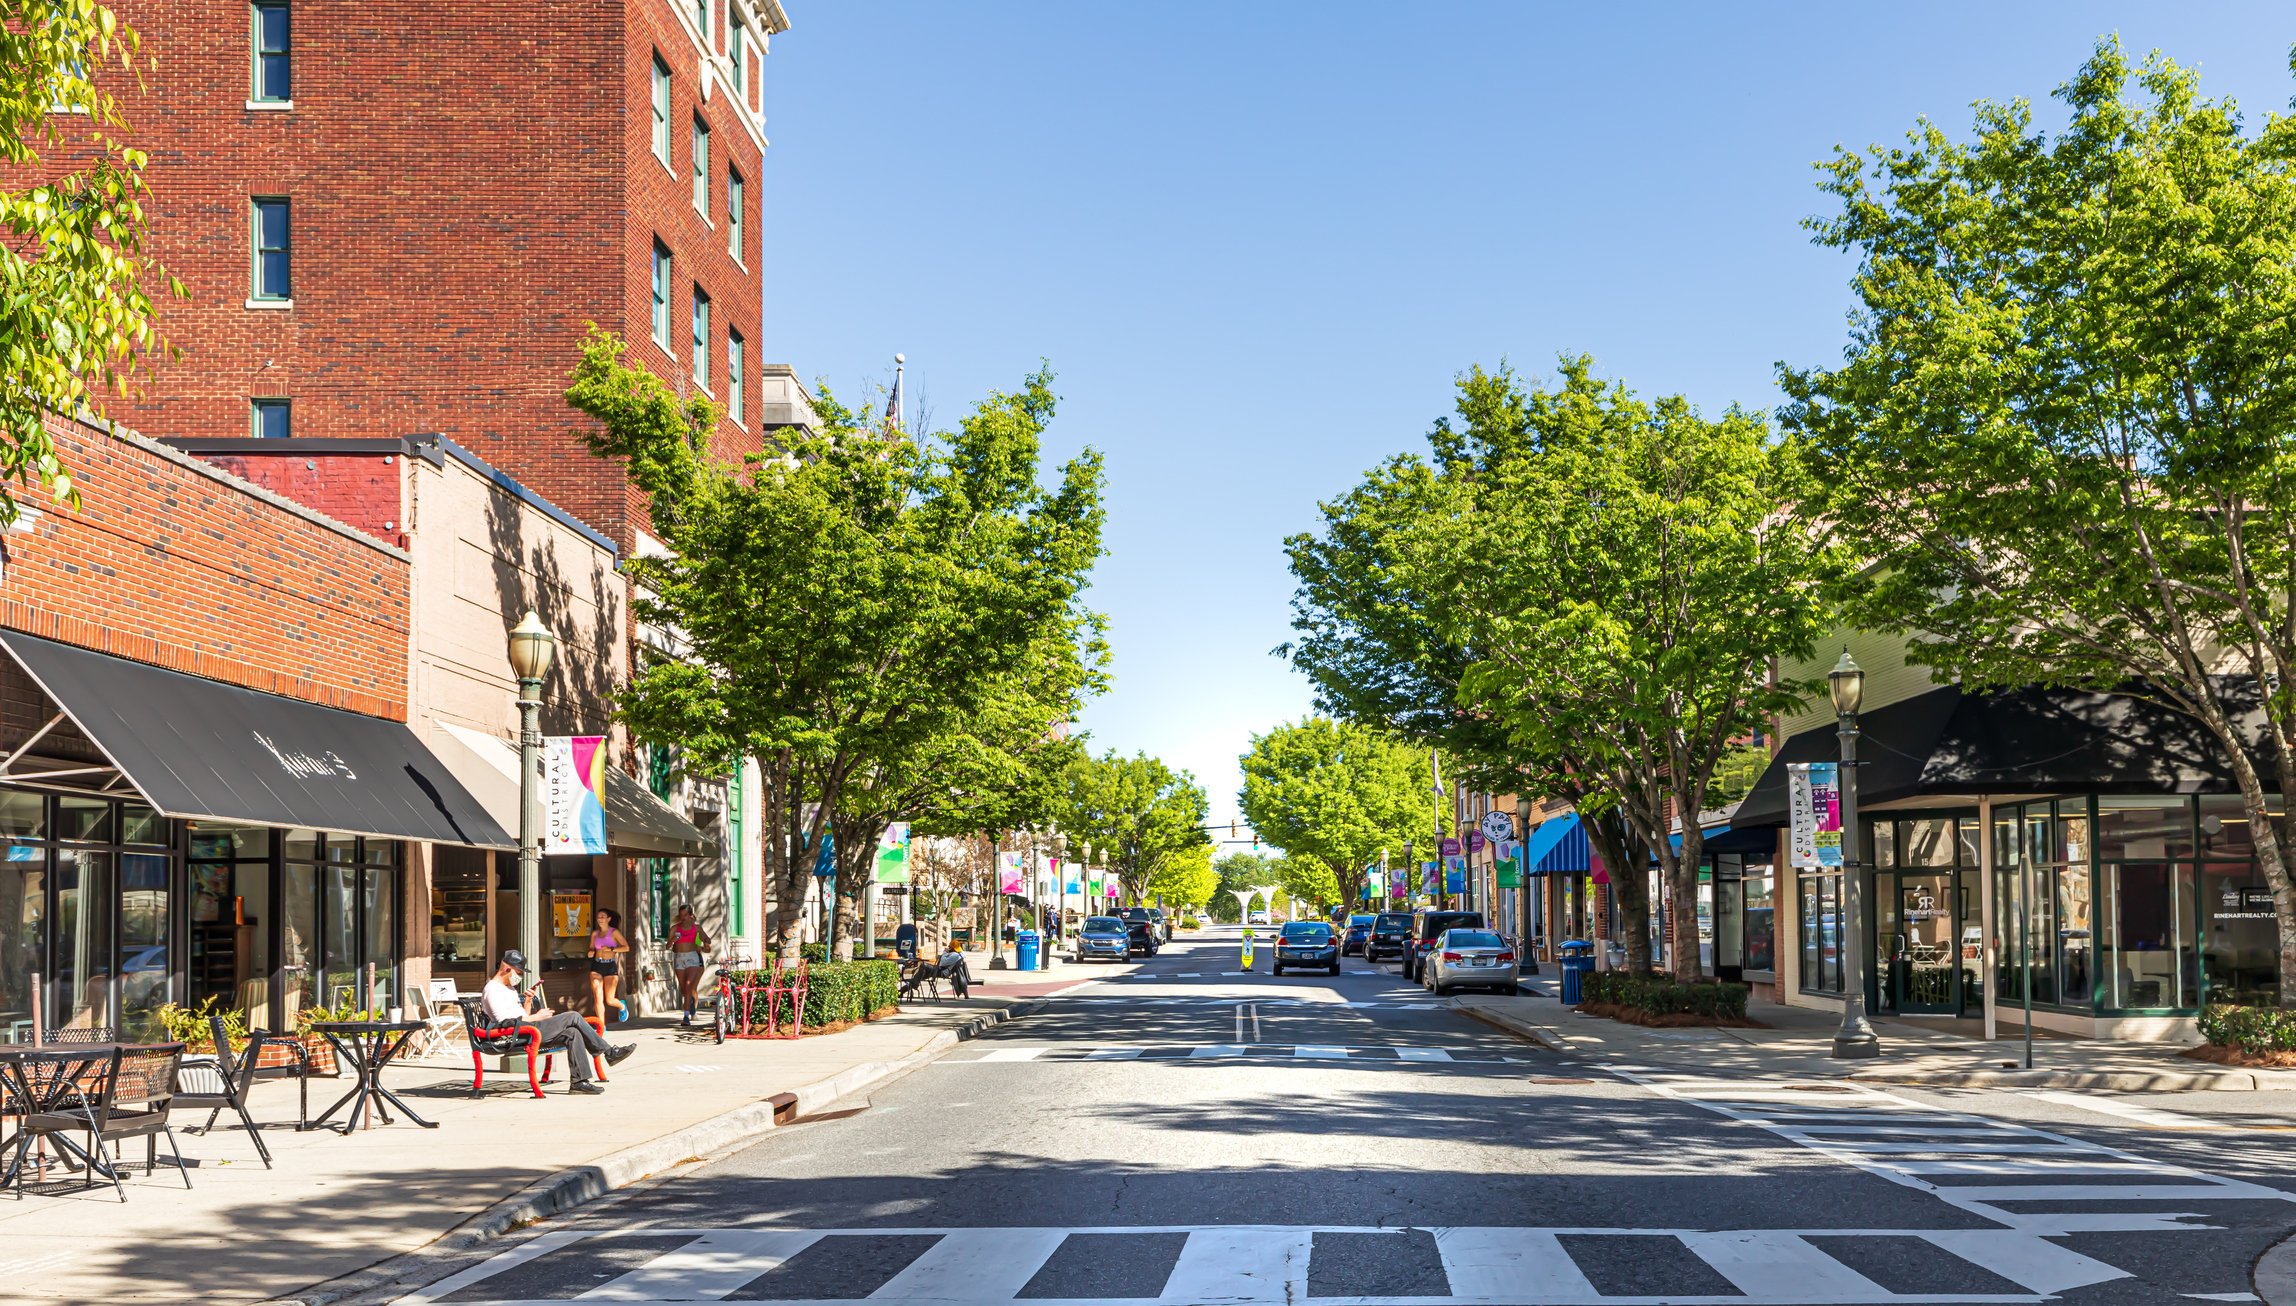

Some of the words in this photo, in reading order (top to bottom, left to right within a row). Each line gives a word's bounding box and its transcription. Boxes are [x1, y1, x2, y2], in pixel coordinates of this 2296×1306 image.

[552, 755, 560, 838] CULTURAL
[1493, 812, 1511, 825] PAPI
[1921, 858, 1929, 866] 15
[554, 896, 575, 904] COMING
